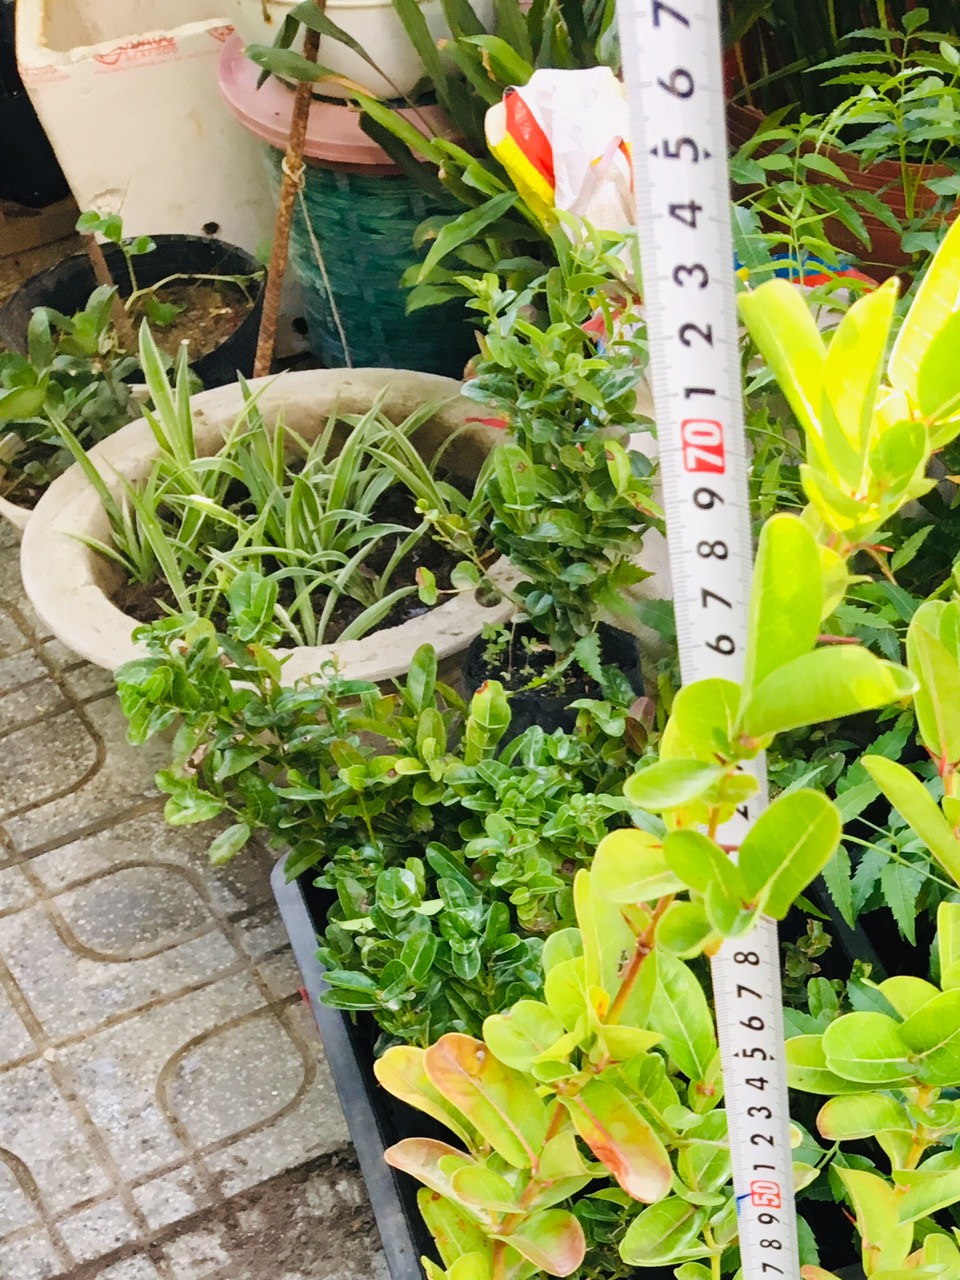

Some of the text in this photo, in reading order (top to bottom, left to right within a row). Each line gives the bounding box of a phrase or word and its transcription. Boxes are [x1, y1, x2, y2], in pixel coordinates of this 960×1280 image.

[651, 0, 690, 28] 7
[658, 68, 695, 100] 6
[663, 137, 700, 164] 5
[668, 200, 703, 229] 4
[673, 263, 709, 289] 3
[679, 323, 713, 347] 2
[685, 387, 716, 399] 1
[685, 421, 724, 471] 70
[693, 487, 724, 510] 9
[697, 540, 729, 561] 8
[701, 588, 733, 609] 7
[706, 634, 736, 656] 6
[733, 951, 760, 966] 8
[736, 984, 763, 999] 7
[739, 1015, 765, 1031] 6
[742, 1047, 767, 1062] 5
[745, 1076, 769, 1091] 4
[747, 1106, 773, 1120] 3
[750, 1133, 774, 1147] 2
[753, 1182, 780, 1207] 50
[757, 1212, 780, 1225] 9
[759, 1238, 783, 1251] 8
[761, 1262, 784, 1275] 7
